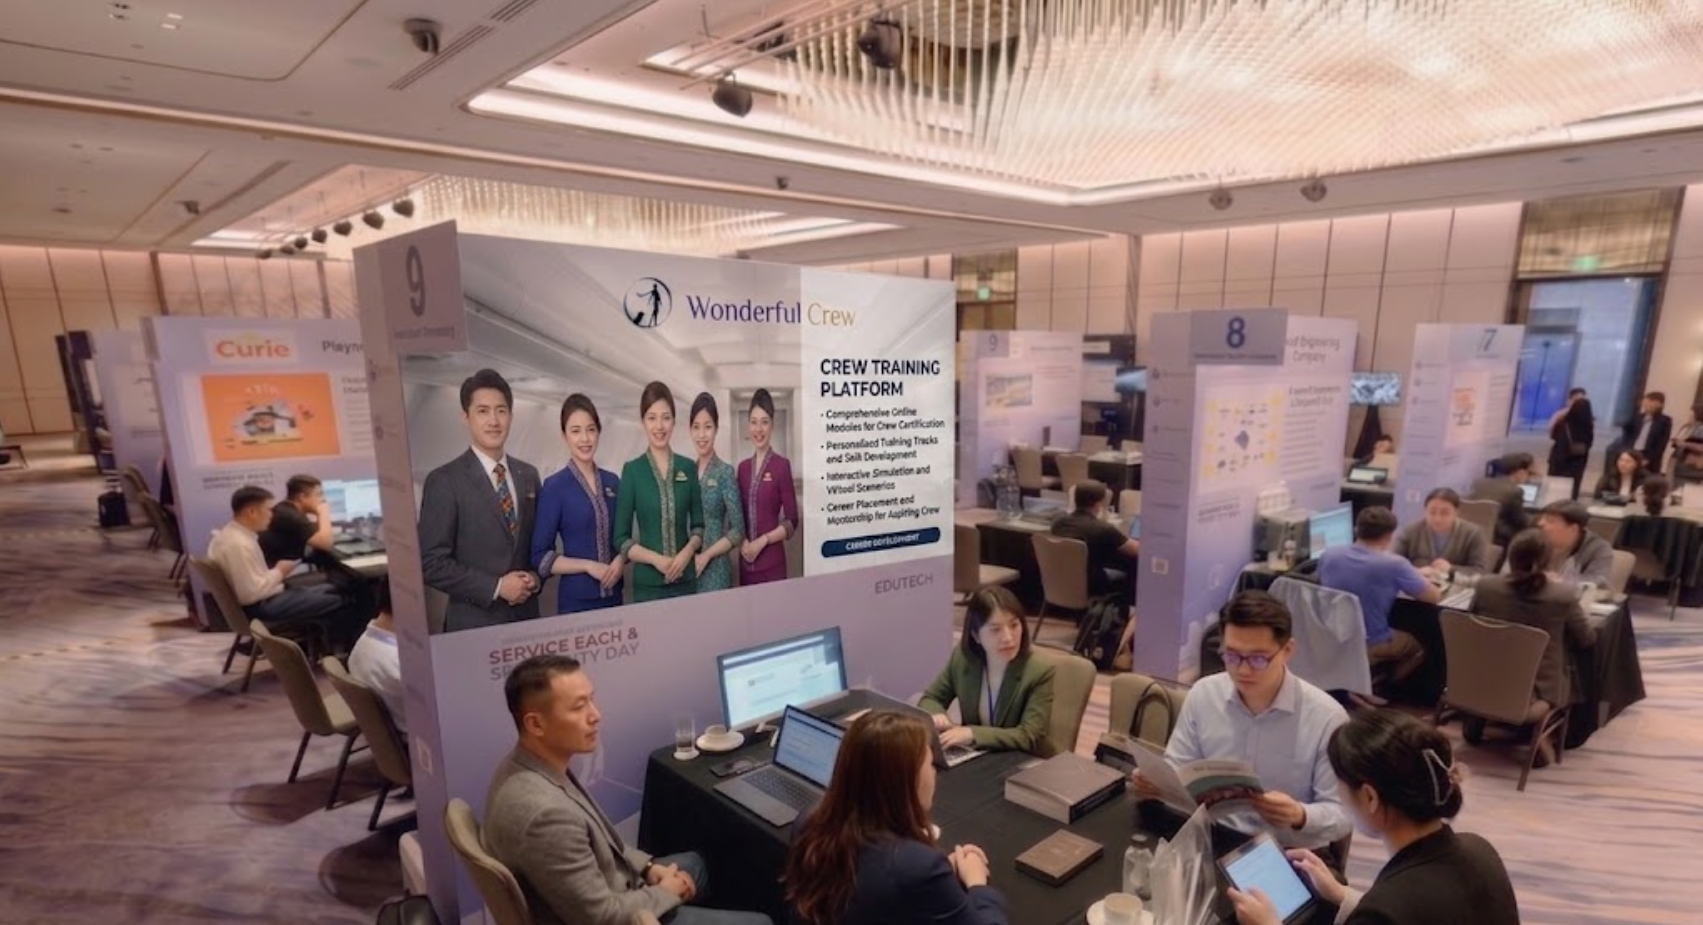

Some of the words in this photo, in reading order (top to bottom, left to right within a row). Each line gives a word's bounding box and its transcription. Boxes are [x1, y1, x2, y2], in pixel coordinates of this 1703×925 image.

[406, 245, 426, 317] 9
[686, 295, 801, 324] Wonderful
[807, 302, 856, 326] Crew
[1226, 316, 1246, 349] 8
[1480, 328, 1498, 352] 7
[216, 339, 290, 358] Curie
[820, 359, 868, 375] CREW
[871, 359, 941, 375] TRAINING
[821, 381, 903, 397] PLATFORM
[875, 573, 934, 595] EDUTECH
[489, 639, 569, 665] SERVICE
[574, 629, 622, 650] EACH
[627, 627, 639, 640] &
[605, 642, 640, 661] DAY
